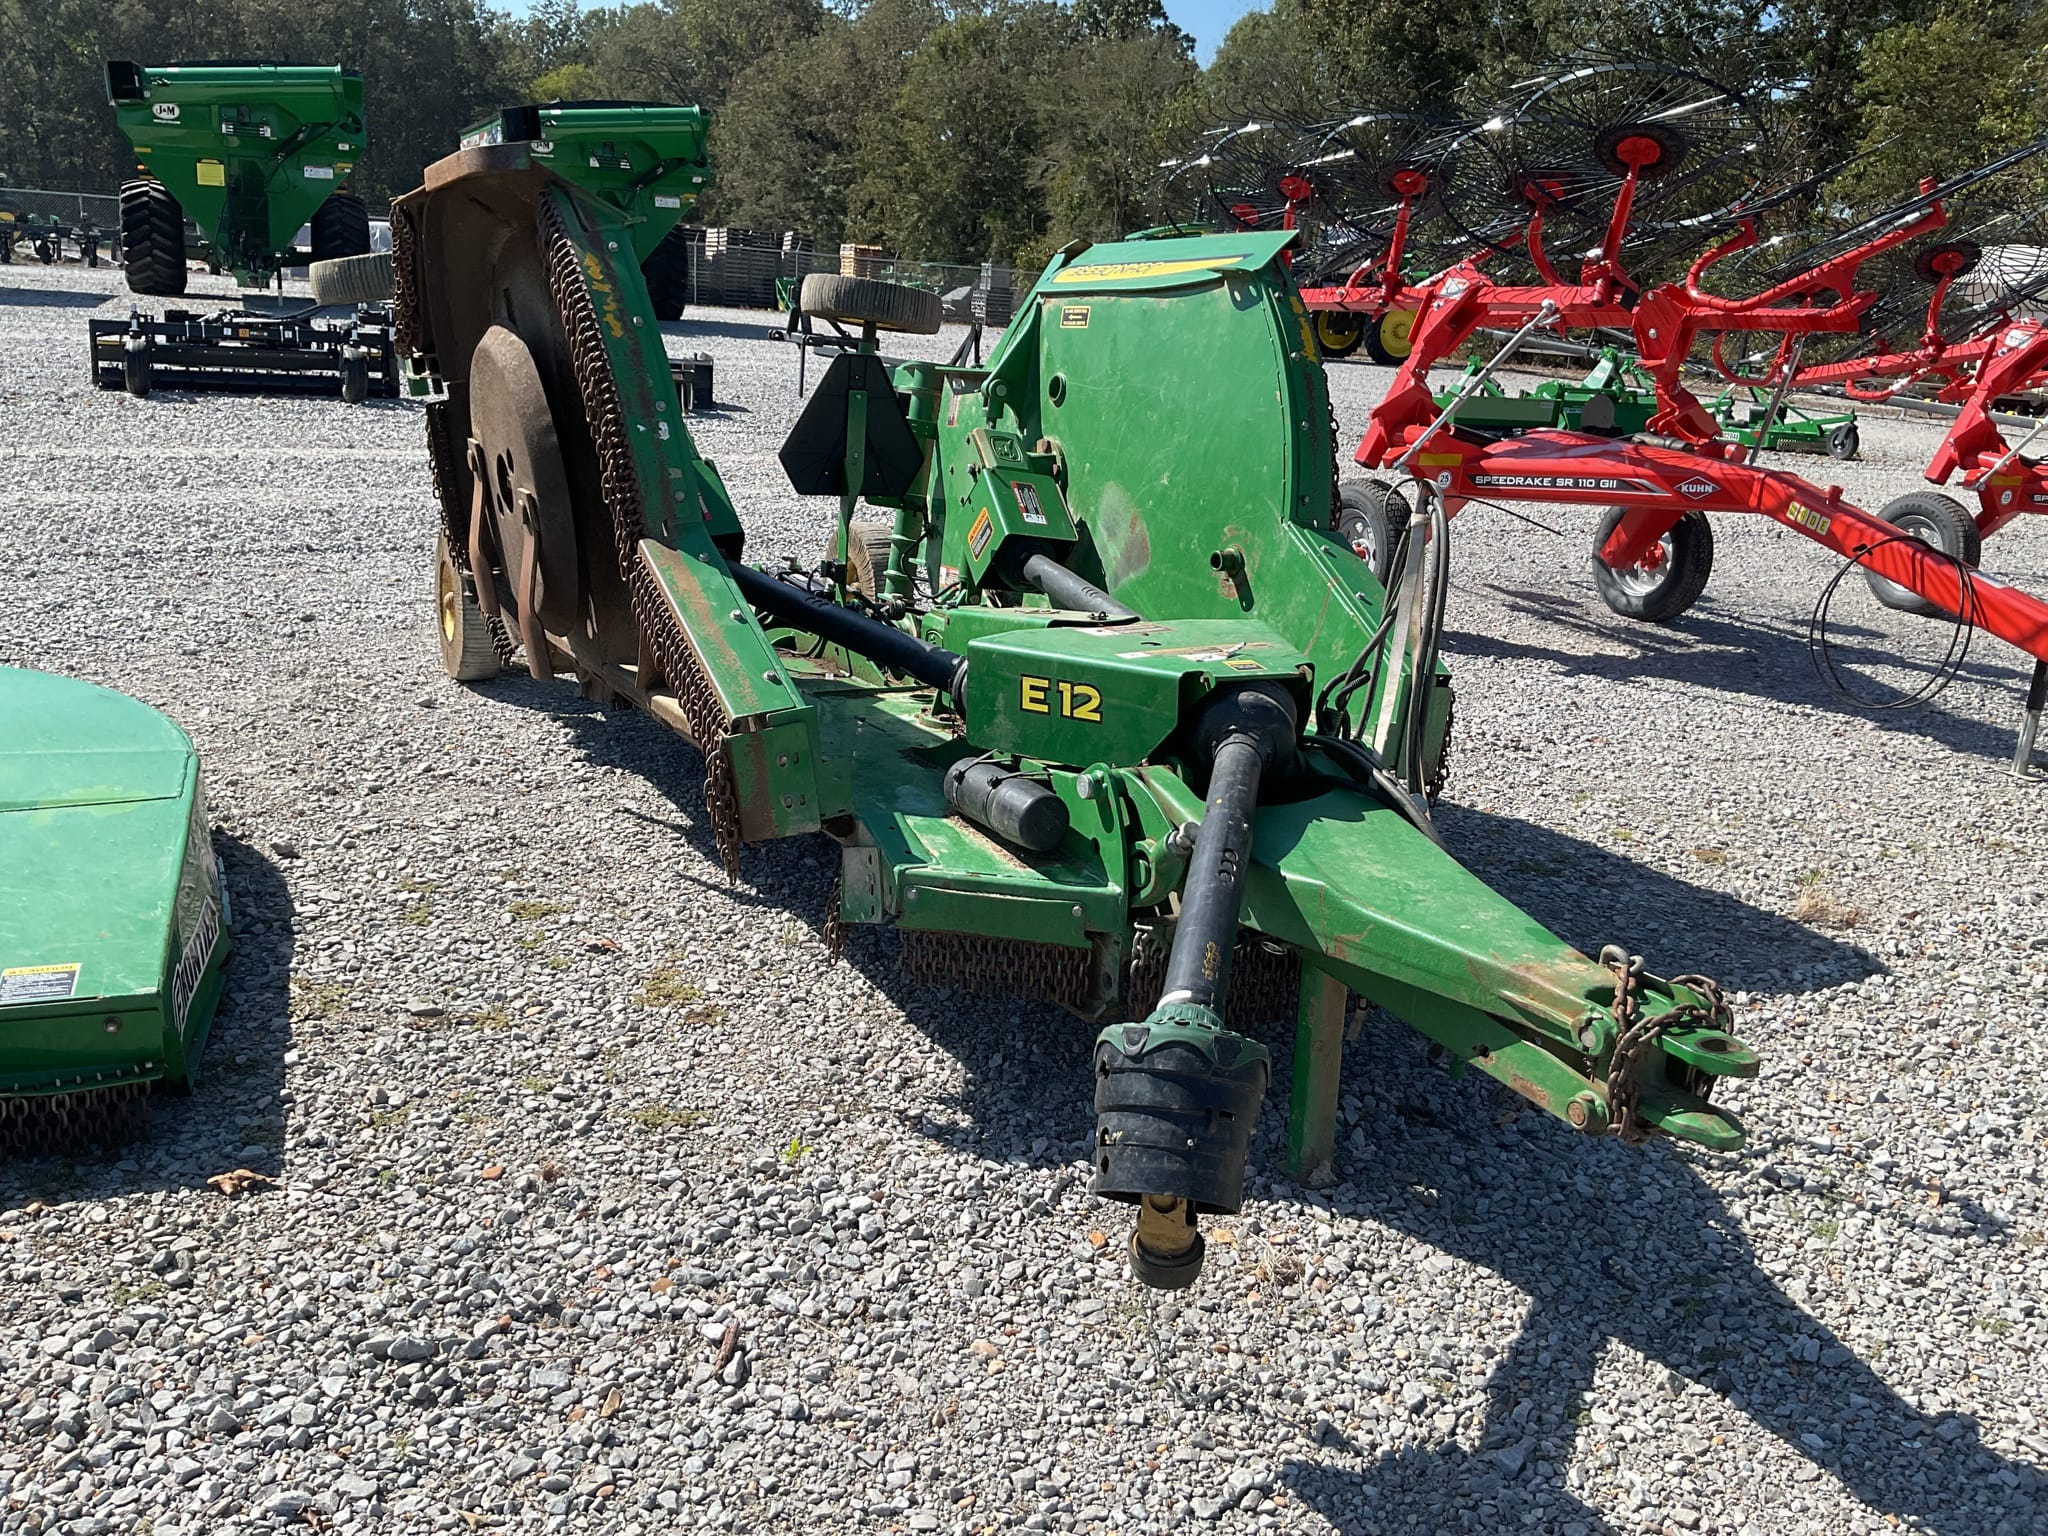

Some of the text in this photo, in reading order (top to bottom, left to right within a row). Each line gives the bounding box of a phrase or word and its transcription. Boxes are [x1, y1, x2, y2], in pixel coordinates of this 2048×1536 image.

[155, 104, 175, 116] J&M
[1474, 475, 1617, 489] SPEEDRAKE SR 110 GII
[1680, 482, 1713, 493] KUHN
